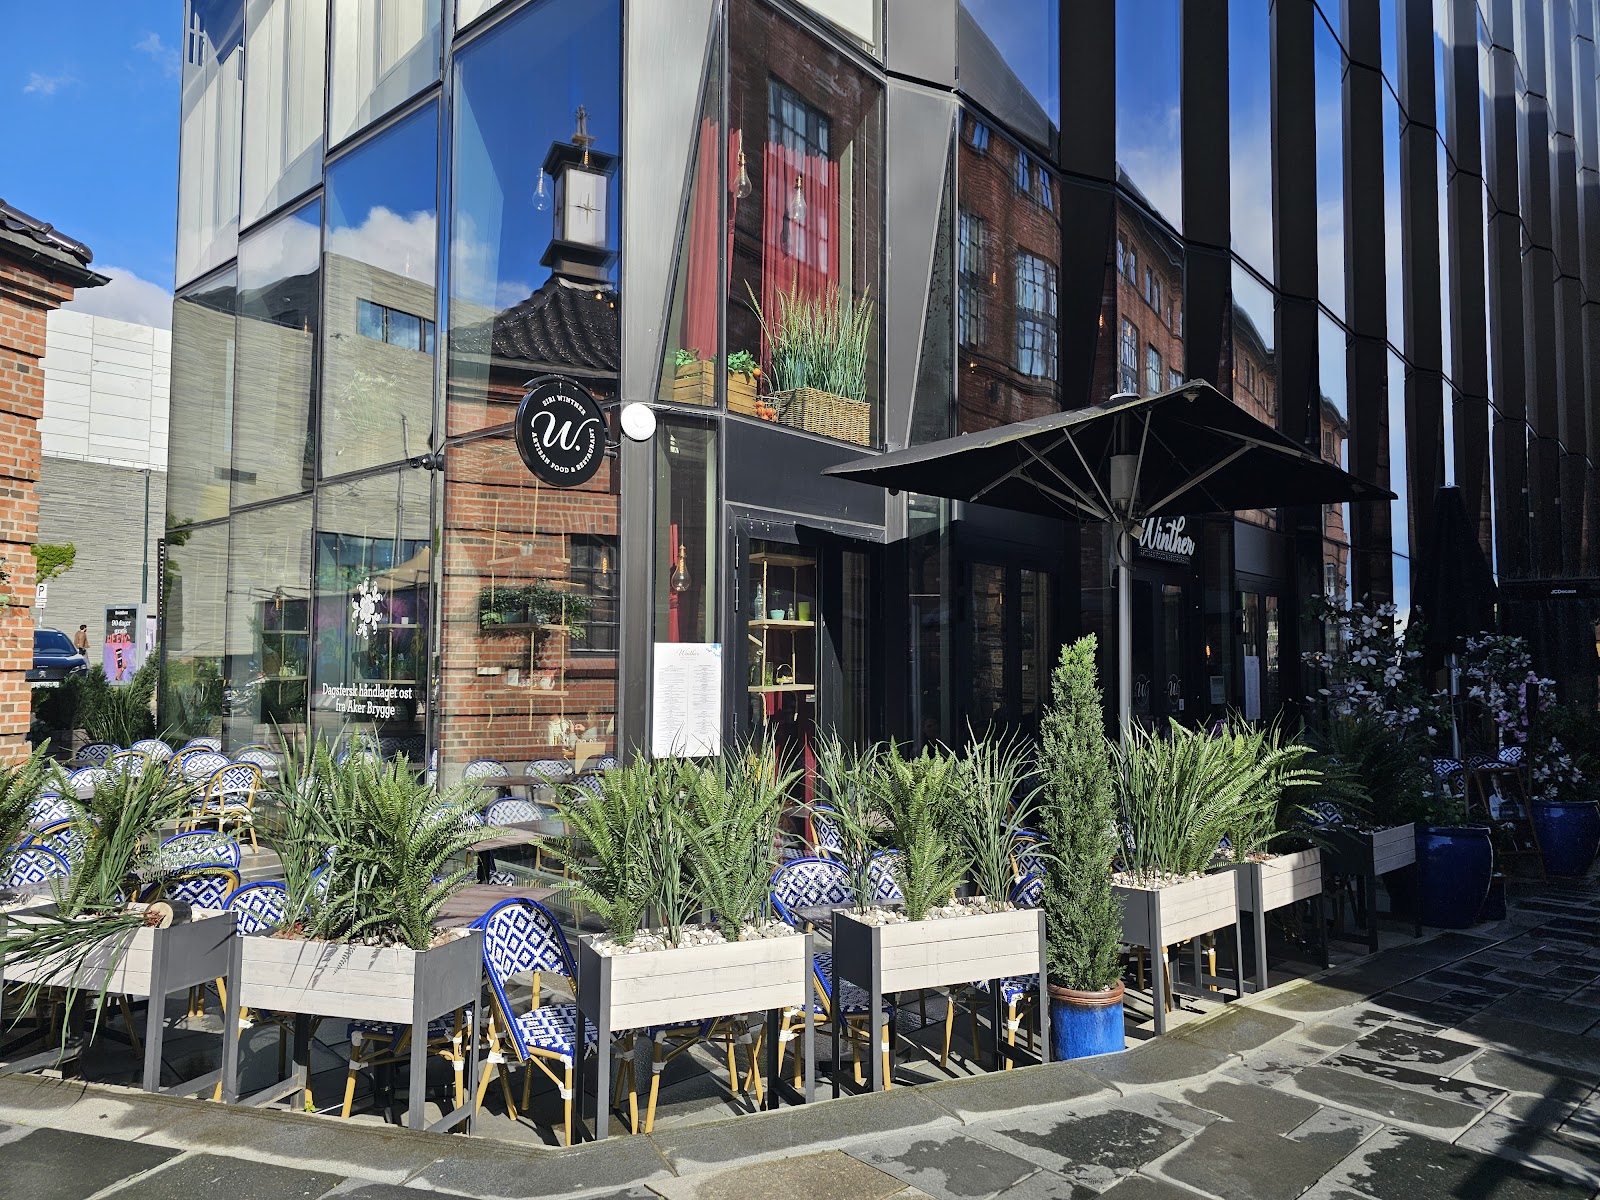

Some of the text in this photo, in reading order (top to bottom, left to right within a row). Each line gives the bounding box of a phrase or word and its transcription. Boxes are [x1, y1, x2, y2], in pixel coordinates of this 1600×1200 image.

[542, 395, 587, 416] SIRI WINTHER
[531, 431, 551, 465] ARTISAN
[550, 462, 570, 473] FOOD
[576, 427, 596, 471] RESTAURANT
[1139, 515, 1195, 556] Winther
[322, 682, 413, 702] Dagsfersk håndlaget ost
[335, 698, 396, 718] fra Aker Brygge
